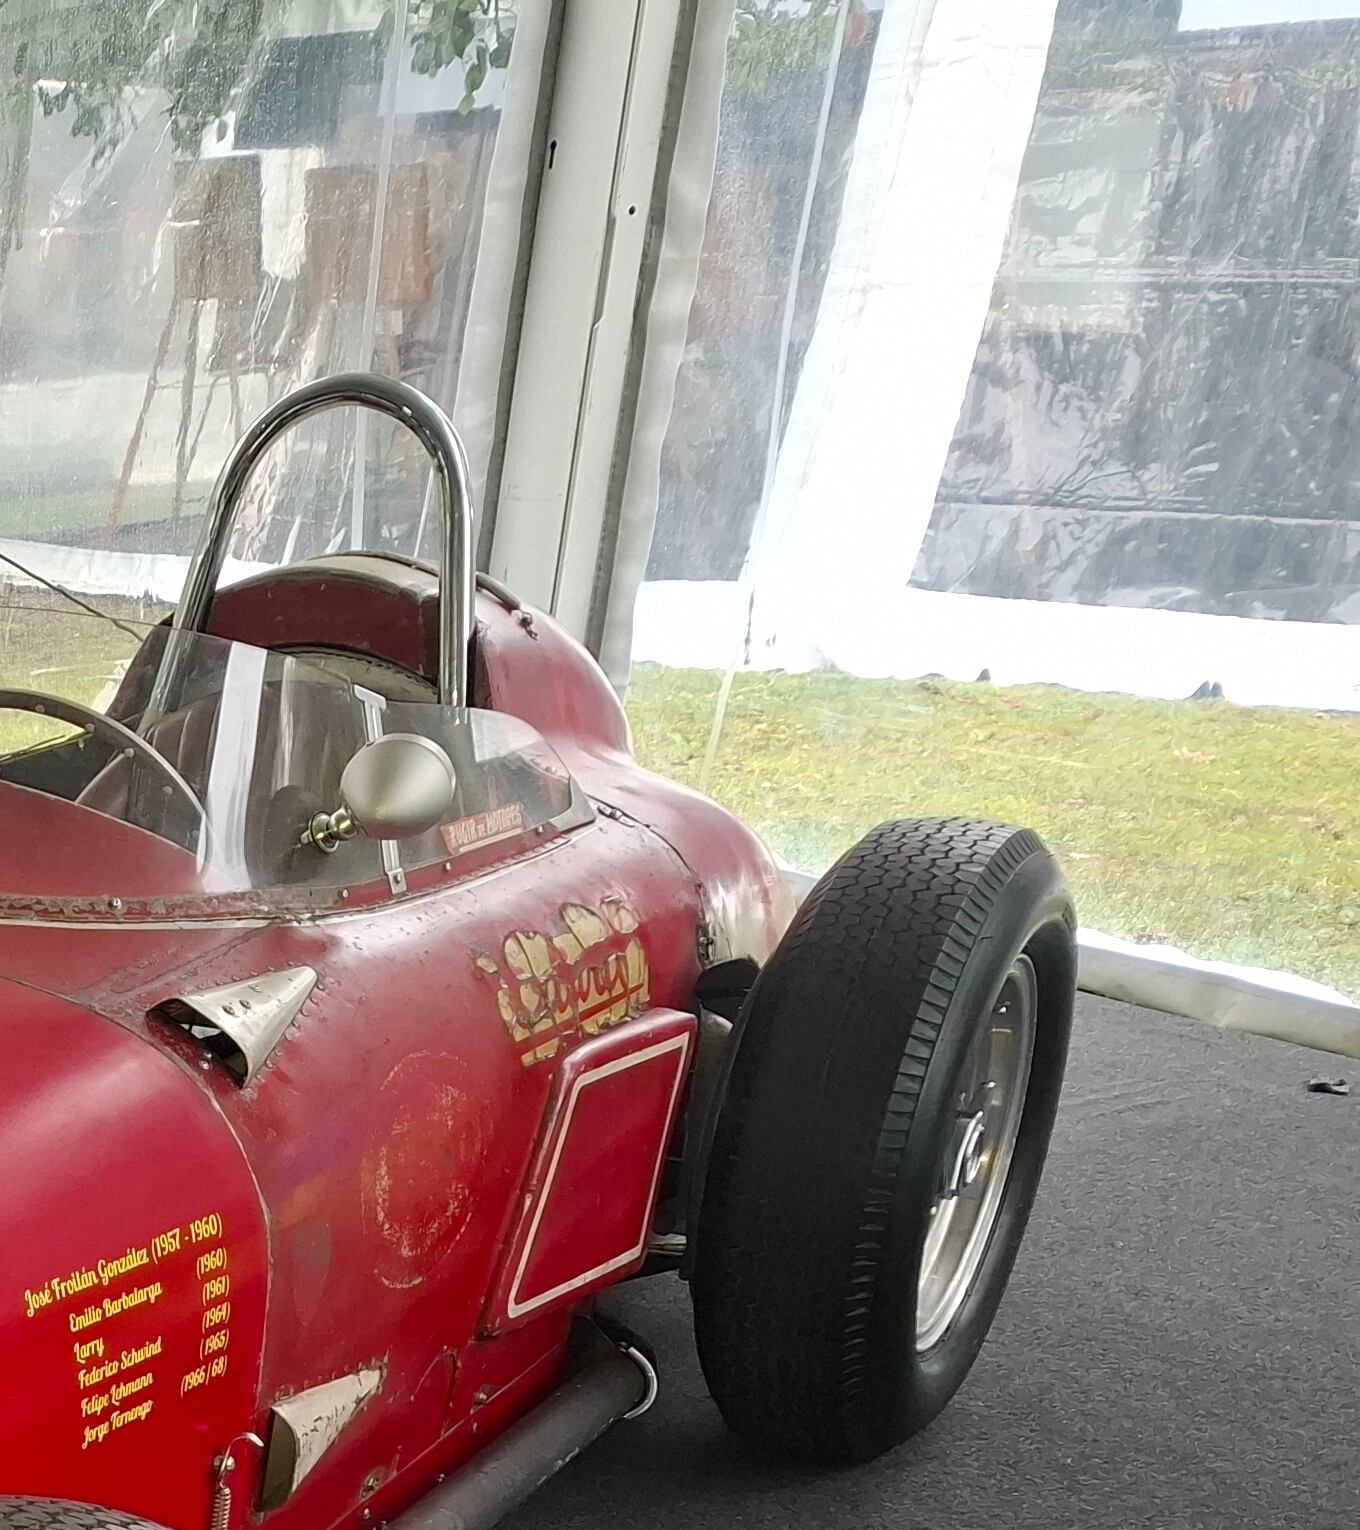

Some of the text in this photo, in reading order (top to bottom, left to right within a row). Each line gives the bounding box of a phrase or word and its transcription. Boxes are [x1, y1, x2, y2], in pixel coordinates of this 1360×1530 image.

[24, 1281, 53, 1318] José
[50, 1266, 99, 1300] Froilán
[97, 1247, 150, 1286] González
[151, 1227, 181, 1265] (1957
[189, 1212, 223, 1244] 1960)
[69, 1246, 228, 1333] Emilio Barbalarga (1960)
[73, 1273, 230, 1365] Larry (1961)
[78, 1301, 231, 1390] Federico Schwind (1964)
[80, 1393, 110, 1418] Felipe
[110, 1372, 154, 1407] Lehmann
[81, 1420, 110, 1450] Jorge
